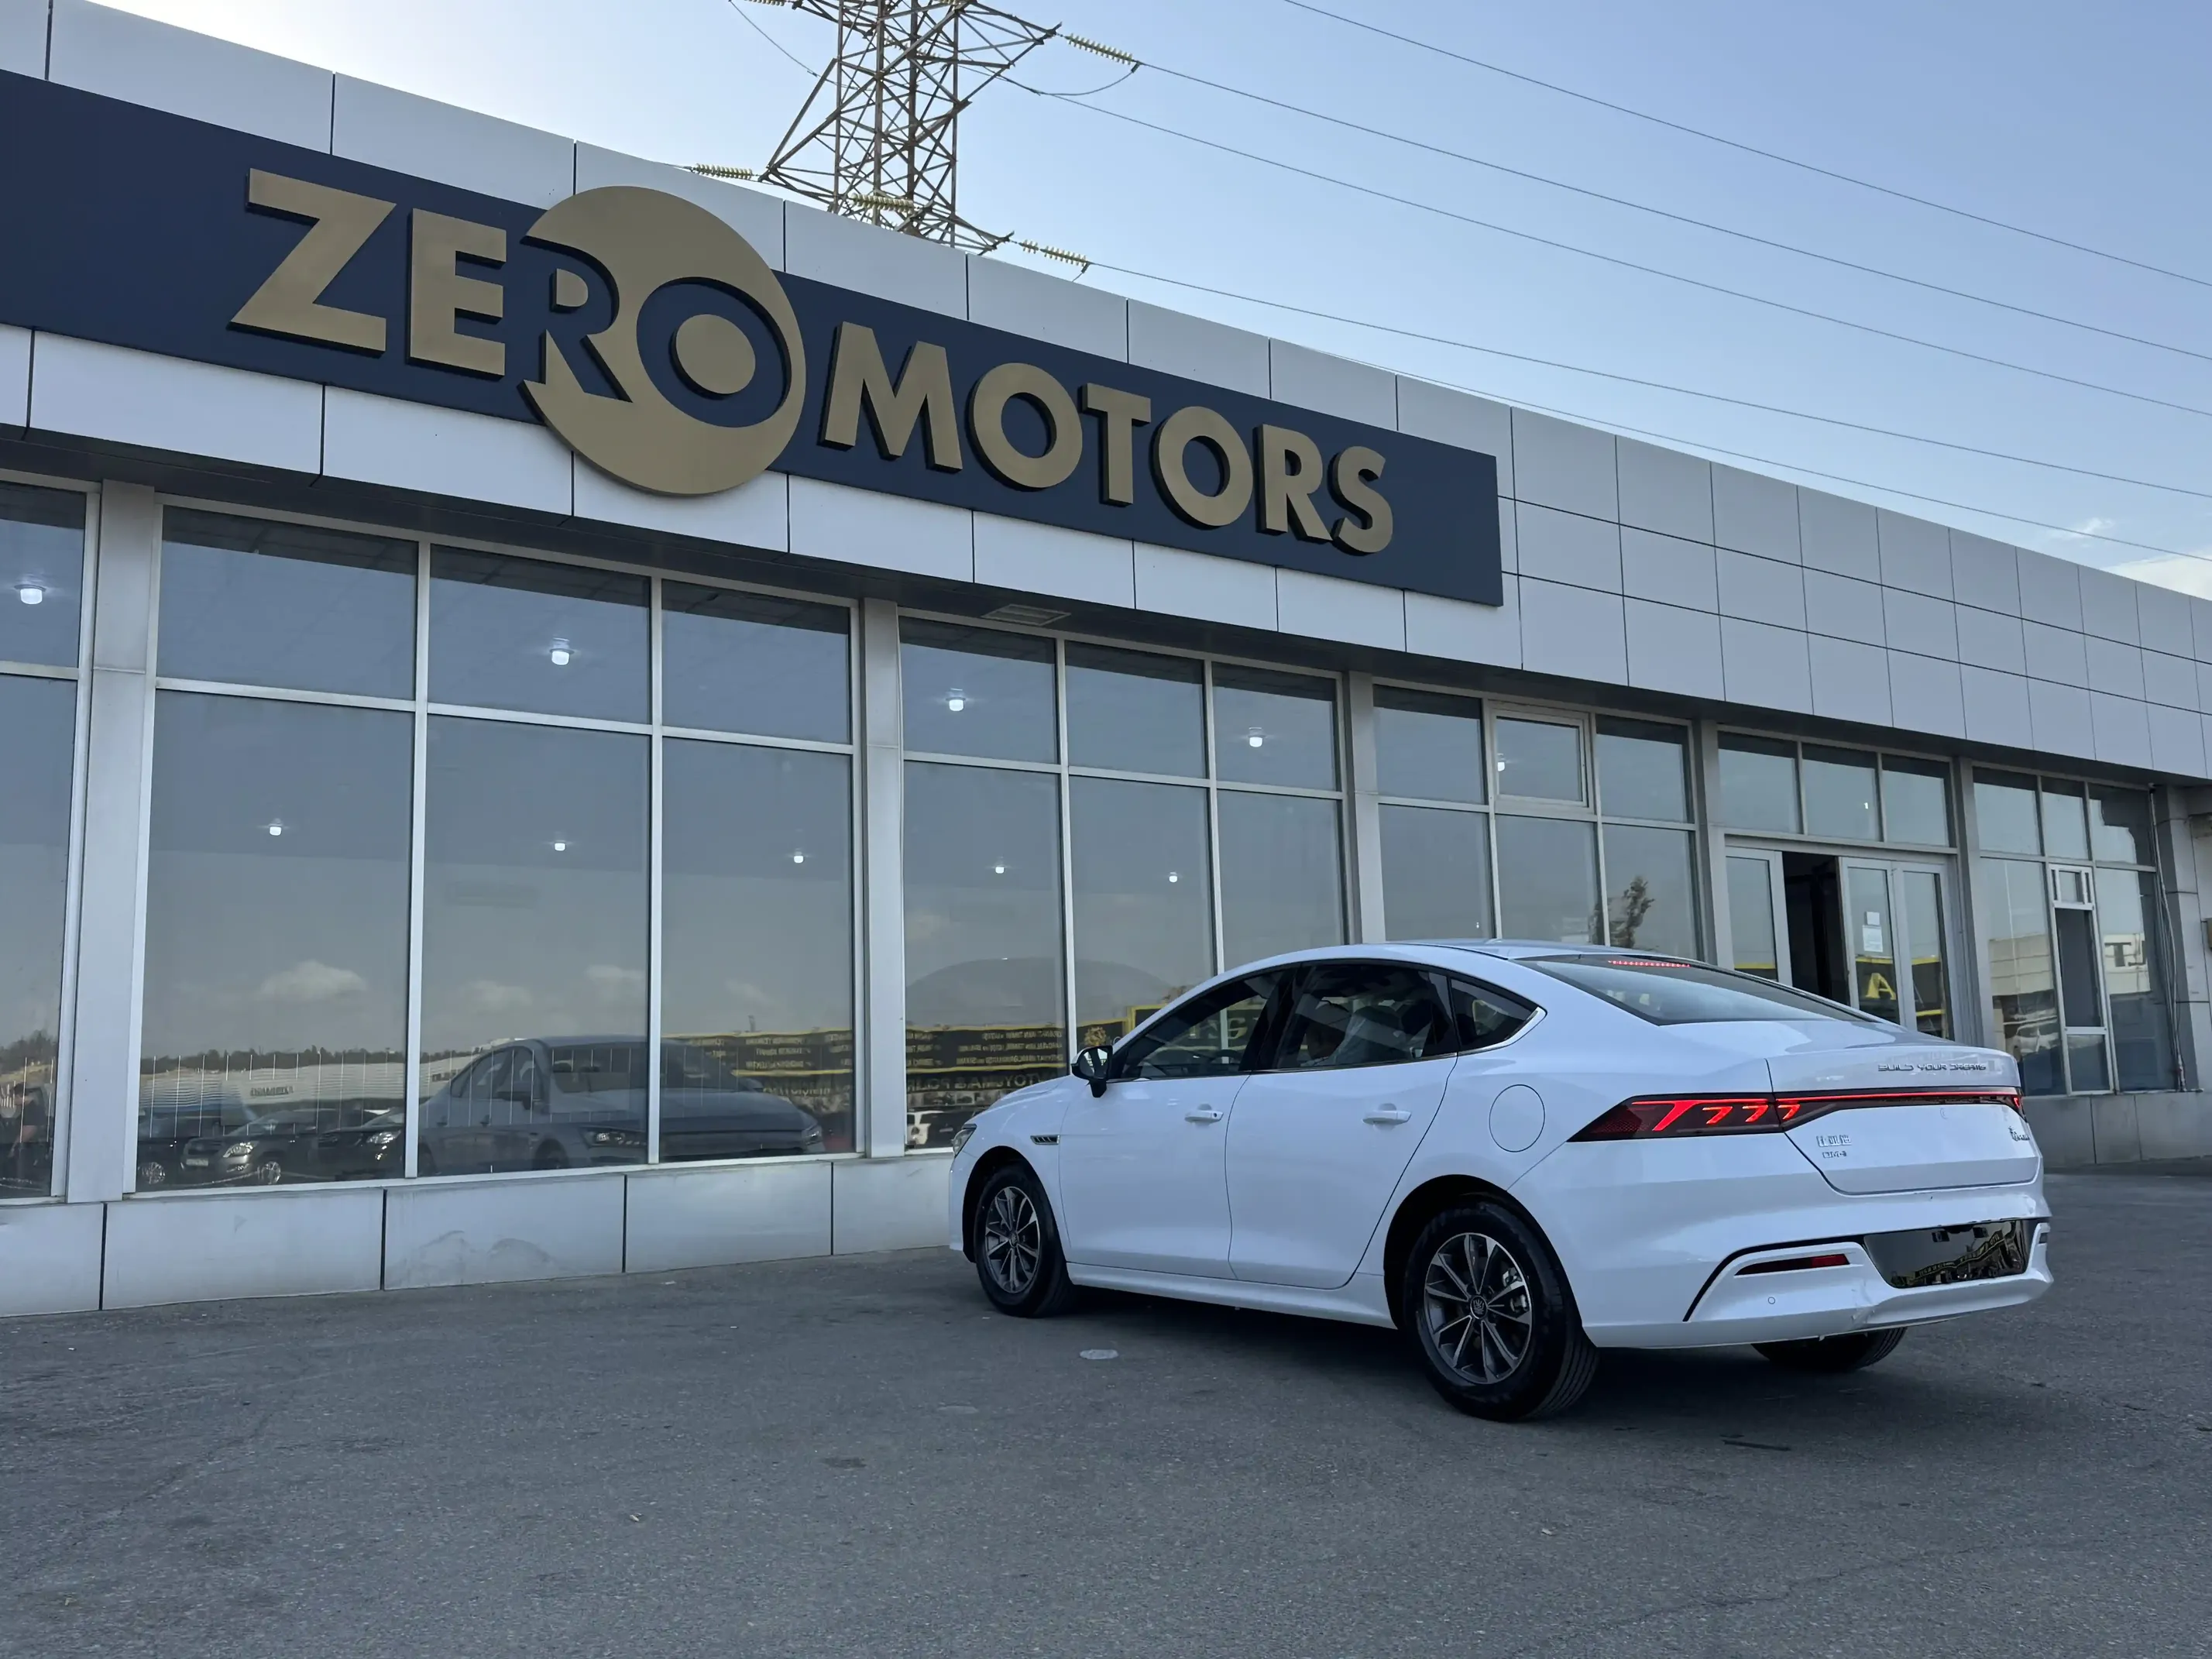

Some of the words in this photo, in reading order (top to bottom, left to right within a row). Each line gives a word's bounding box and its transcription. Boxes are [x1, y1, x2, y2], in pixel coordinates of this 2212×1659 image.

[228, 167, 795, 434] ZERO
[817, 319, 1393, 555] MOTORS
[1877, 1063, 1914, 1072] BUILD
[1949, 1063, 1987, 1071] DREAMS
